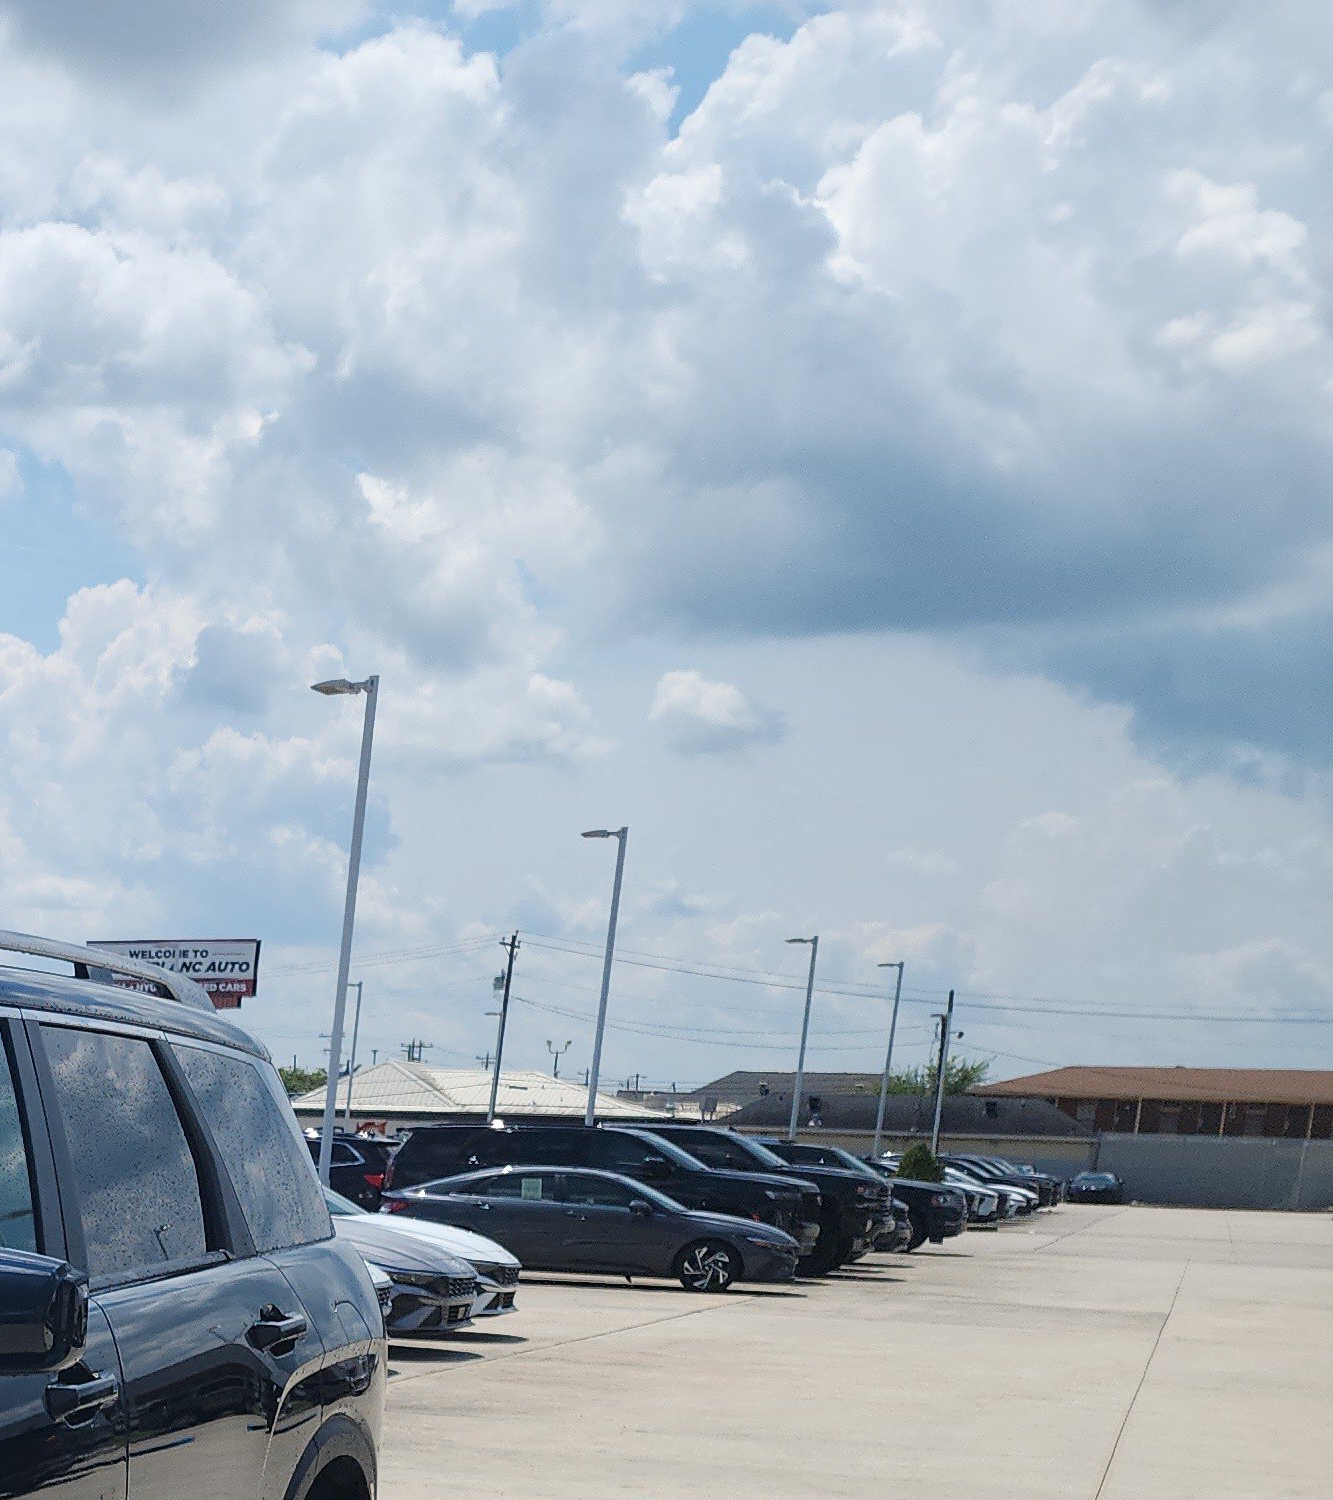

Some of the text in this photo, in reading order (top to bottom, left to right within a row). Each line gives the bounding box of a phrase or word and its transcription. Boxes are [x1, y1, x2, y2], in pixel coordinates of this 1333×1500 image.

[193, 949, 209, 958] TO
[205, 961, 250, 973] AUTO
[219, 982, 247, 993] CARS
